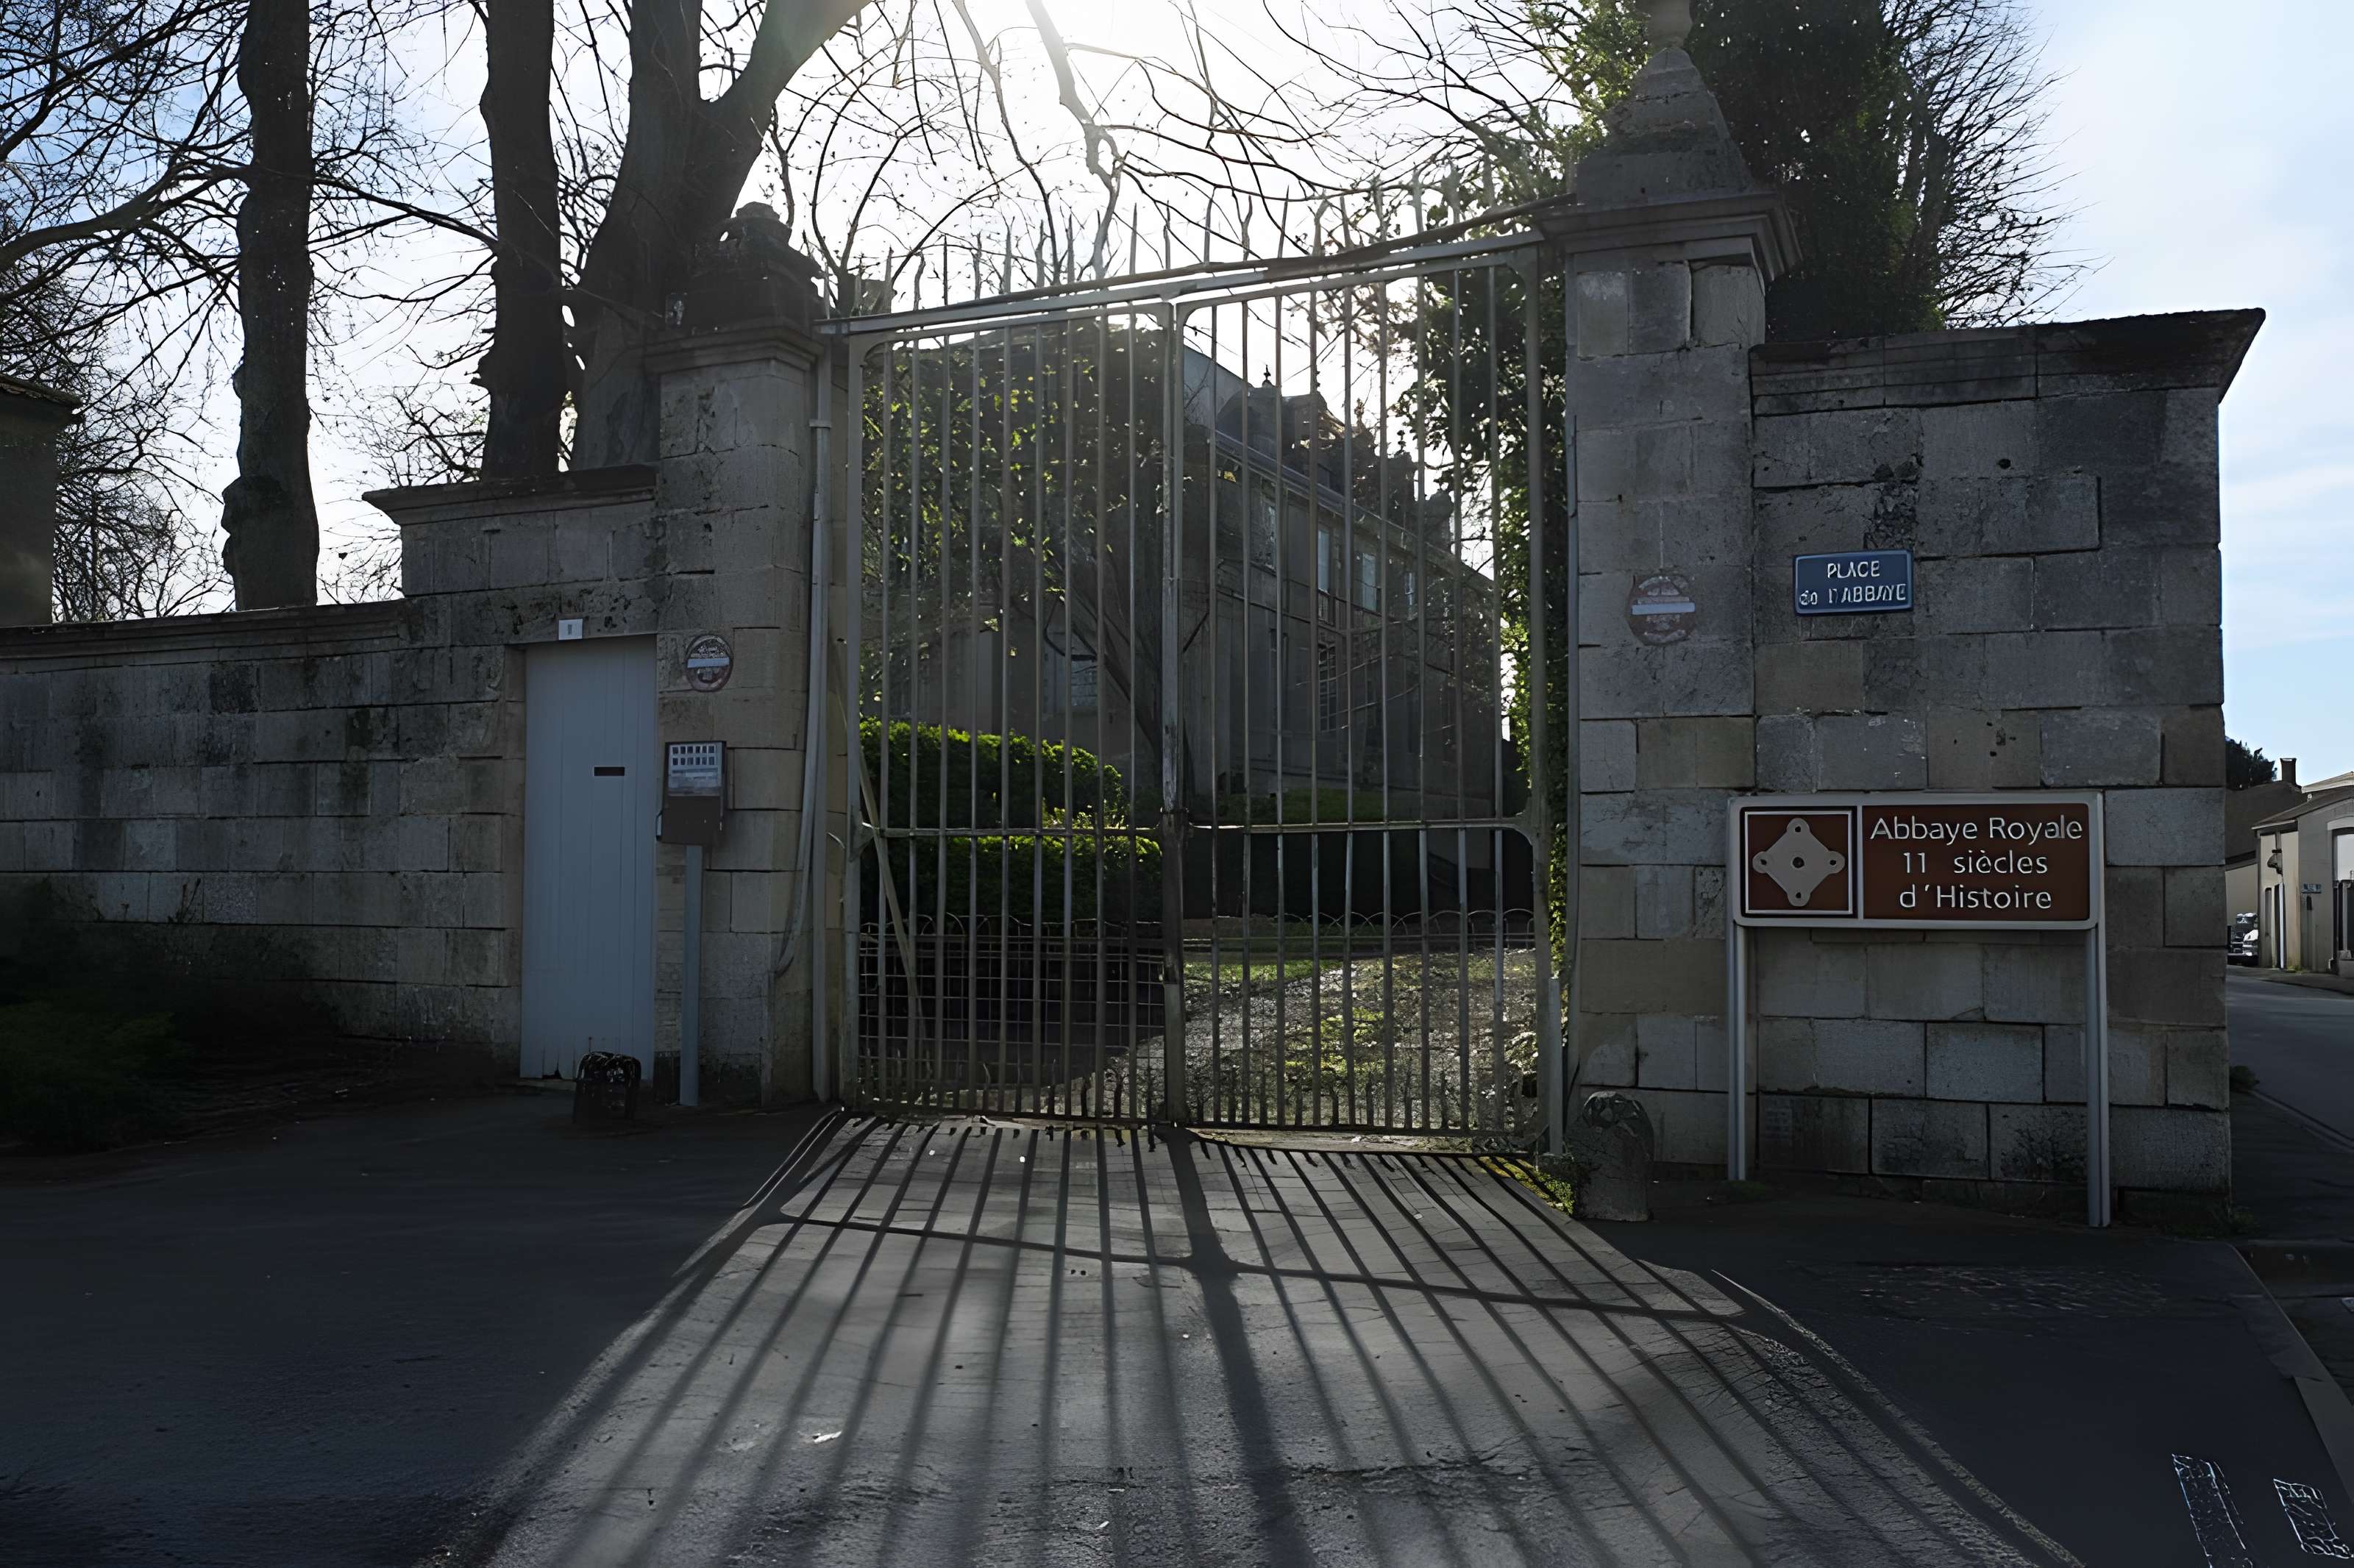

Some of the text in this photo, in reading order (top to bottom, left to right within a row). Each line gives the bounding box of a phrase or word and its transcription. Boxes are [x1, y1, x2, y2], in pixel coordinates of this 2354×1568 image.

[1827, 560, 1880, 578] PLACE
[1870, 814, 2083, 846] Abbaye Royale
[1902, 849, 2049, 874] 11 siècles
[1899, 883, 2052, 910] d'Histoire
